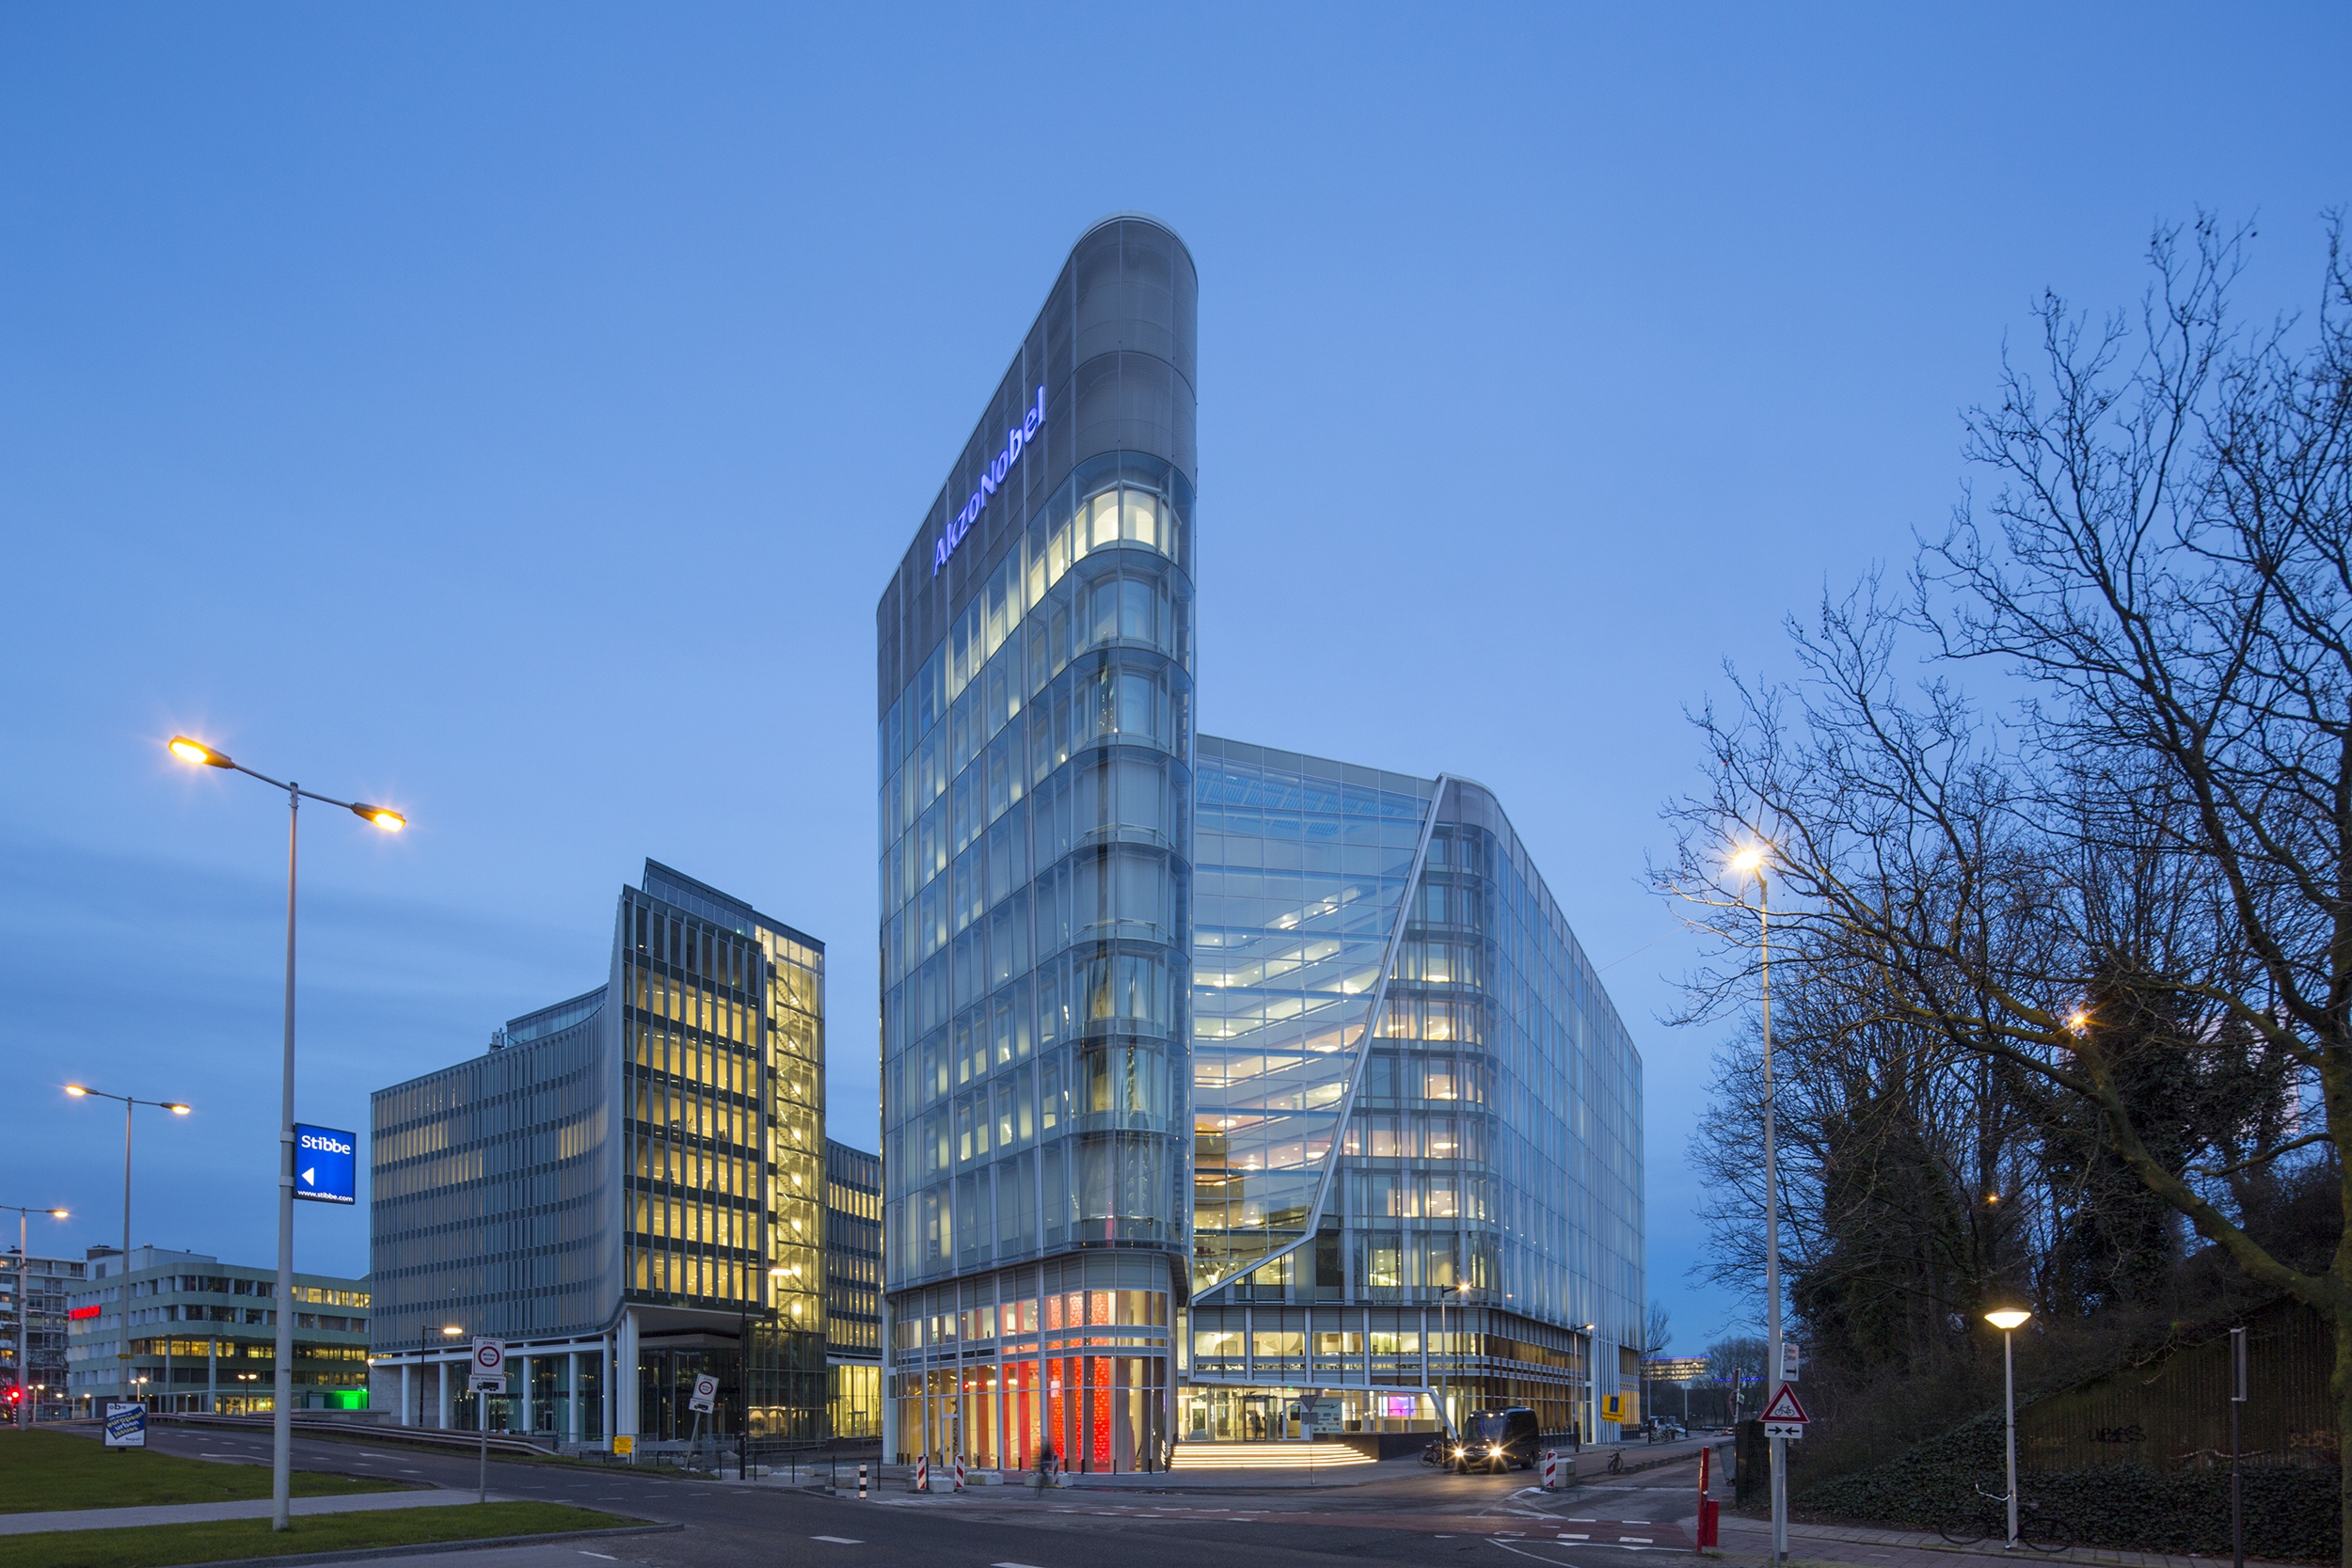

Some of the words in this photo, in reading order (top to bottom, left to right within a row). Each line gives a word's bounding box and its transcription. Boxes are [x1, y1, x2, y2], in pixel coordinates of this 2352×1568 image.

[933, 384, 1046, 578] AkzoNobel
[301, 1134, 351, 1155] Stibbe
[297, 1190, 354, 1202] www.stibbe.com
[107, 1411, 144, 1428] european
[115, 1419, 140, 1431] urban
